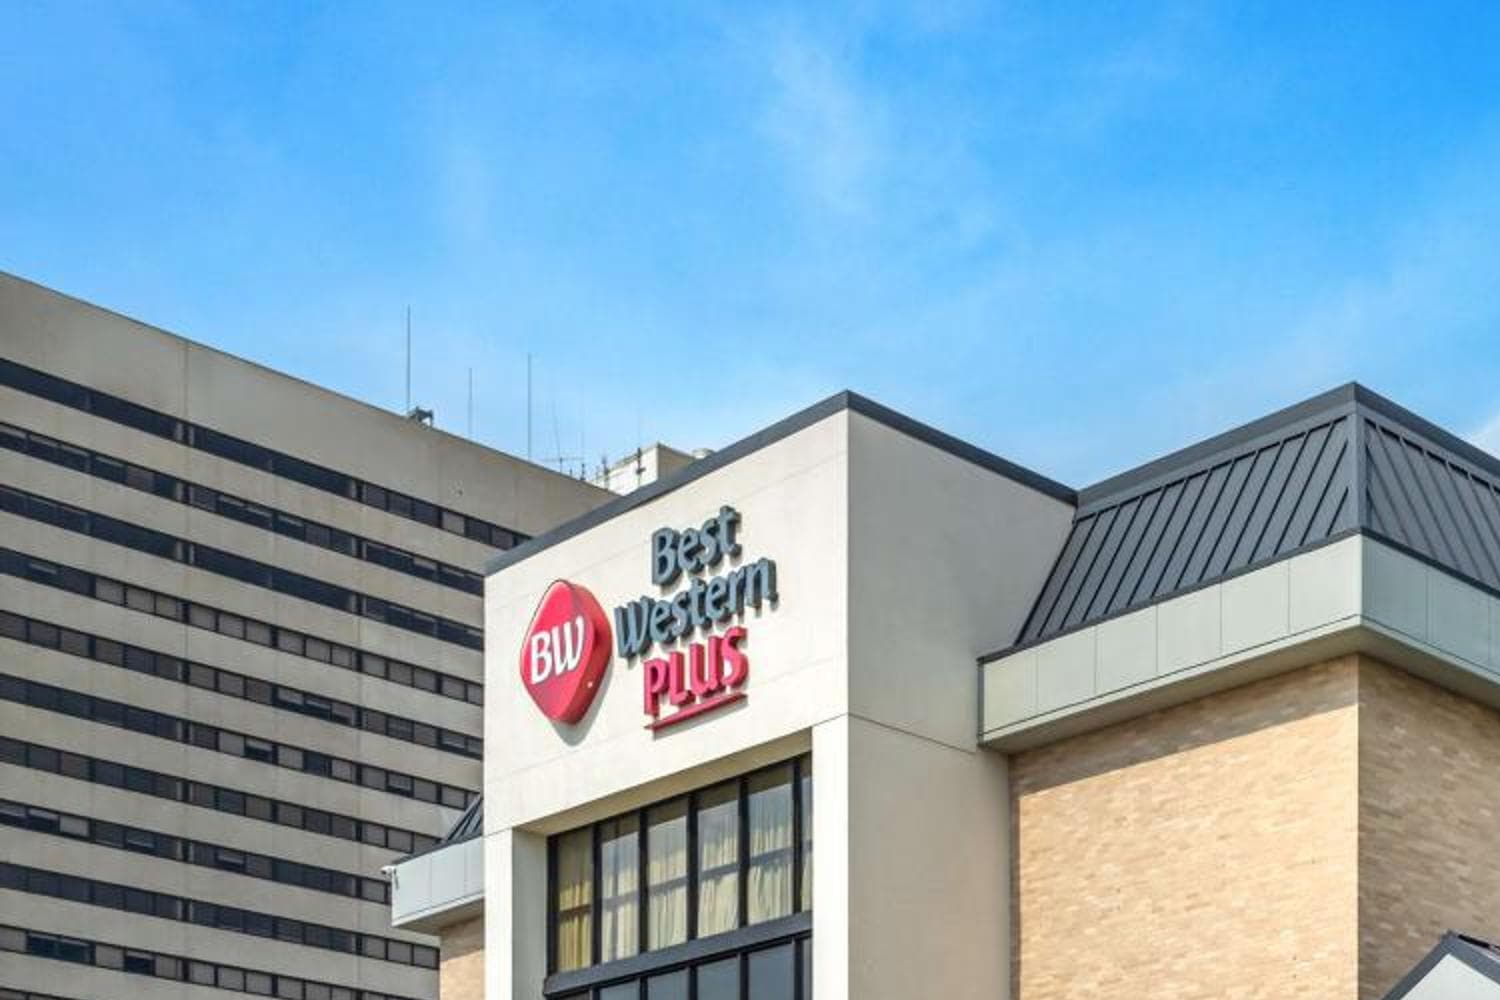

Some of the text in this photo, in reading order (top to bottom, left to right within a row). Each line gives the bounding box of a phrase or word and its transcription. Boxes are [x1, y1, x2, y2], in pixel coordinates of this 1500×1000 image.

[652, 505, 742, 586] Best
[530, 615, 585, 684] BW
[613, 557, 779, 659] Western
[643, 625, 749, 716] PLUS
